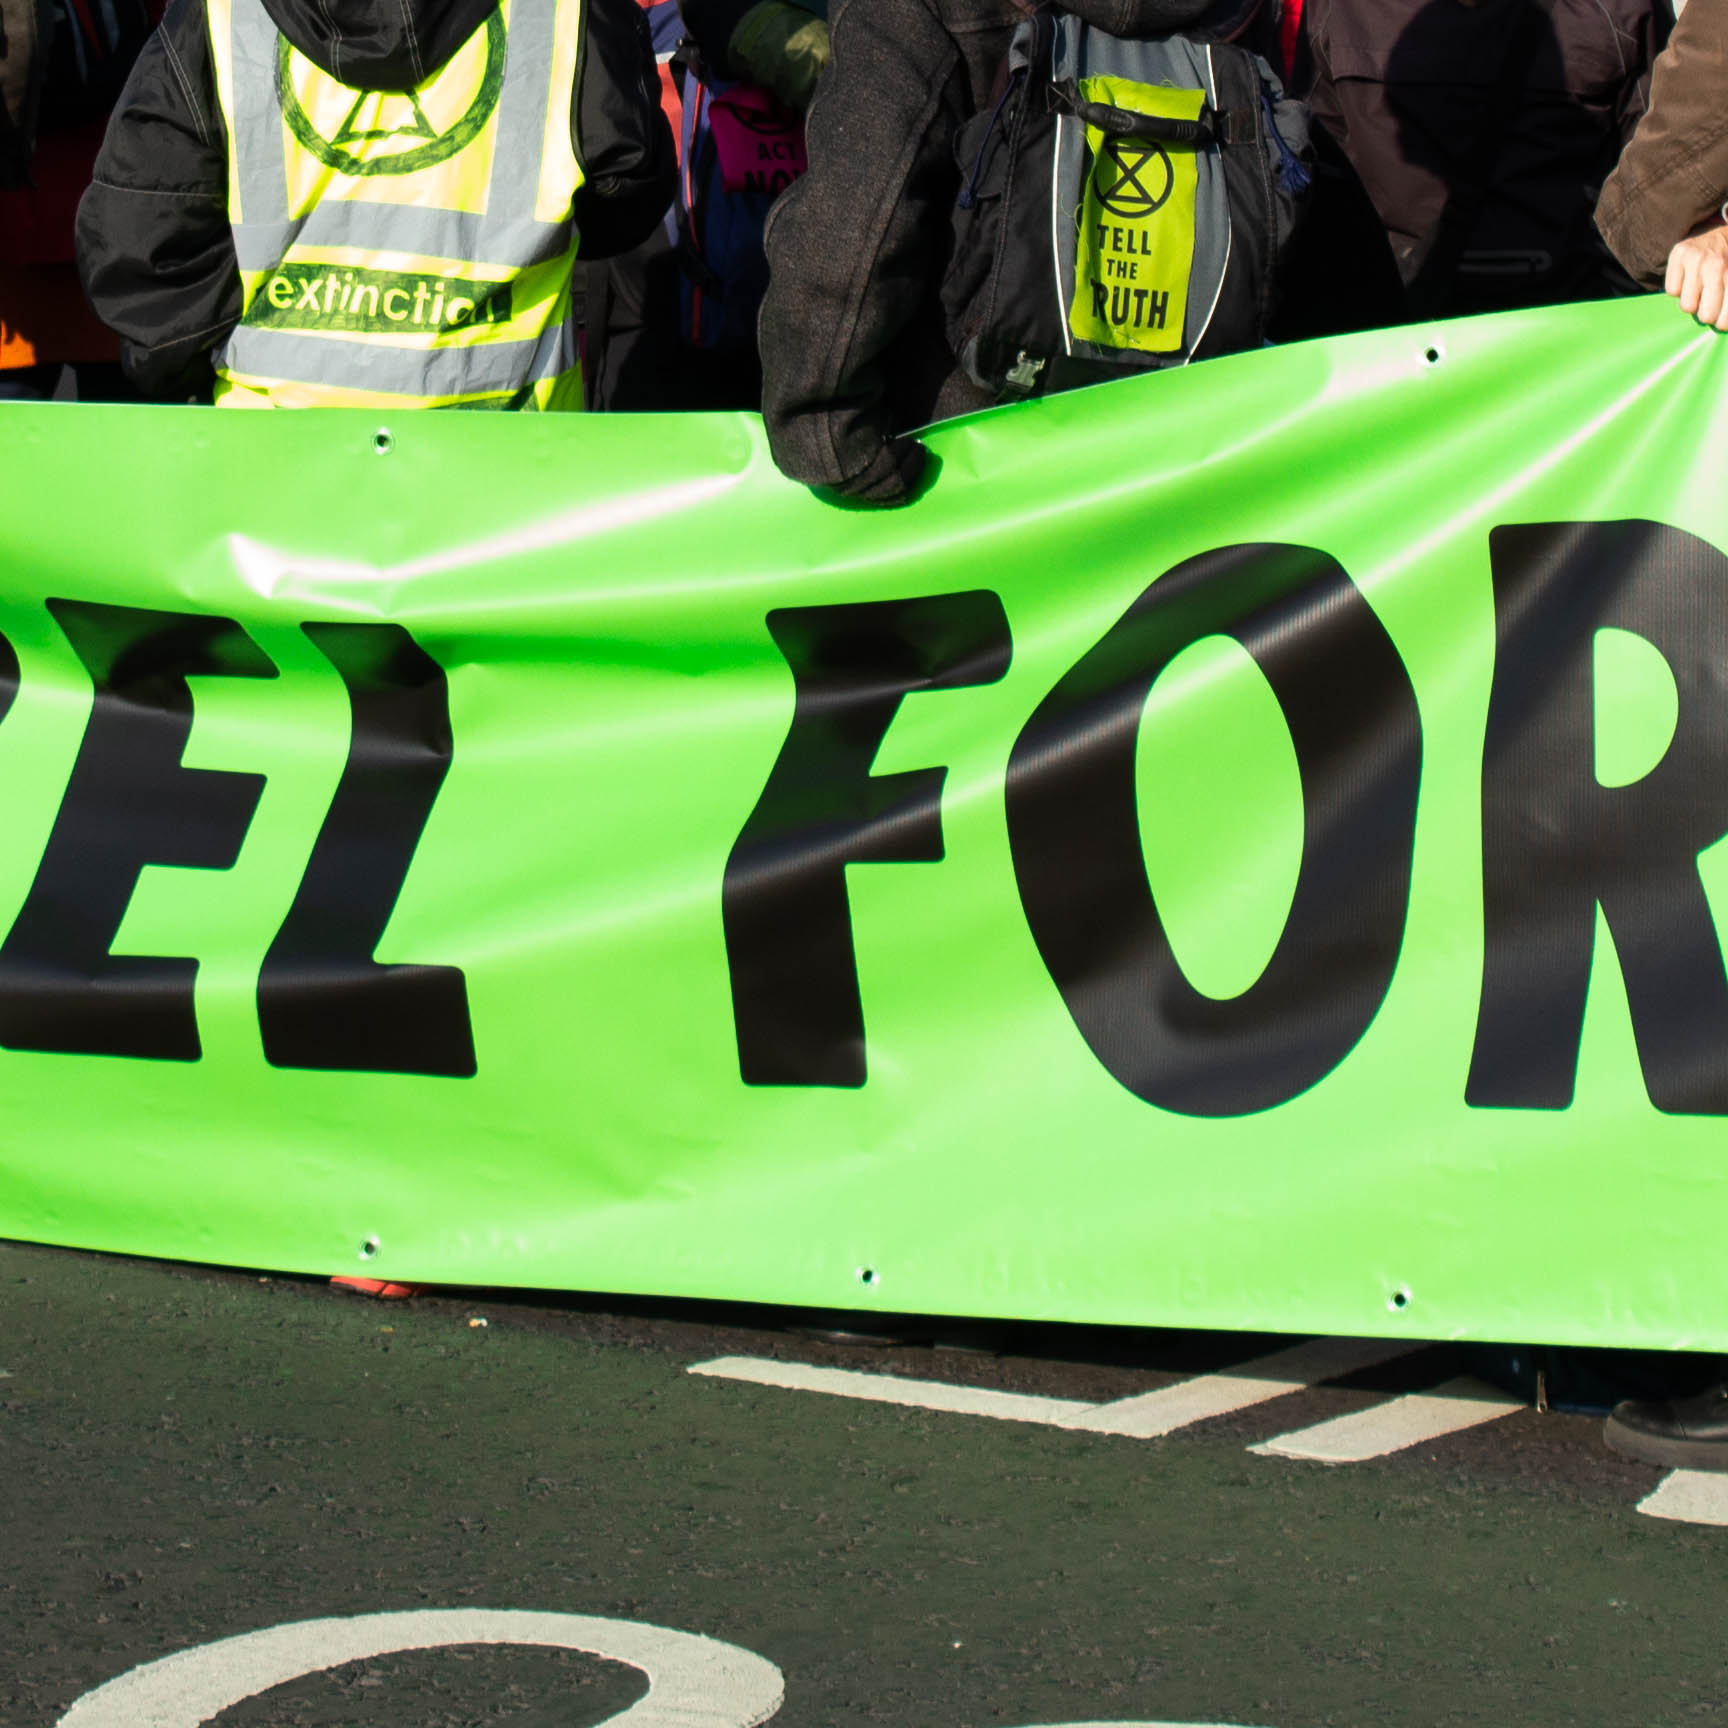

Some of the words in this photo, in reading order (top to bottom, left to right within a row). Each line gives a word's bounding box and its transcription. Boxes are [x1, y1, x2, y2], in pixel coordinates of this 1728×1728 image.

[743, 168, 802, 194] NO
[1097, 224, 1151, 255] TELL
[1107, 259, 1137, 279] THE
